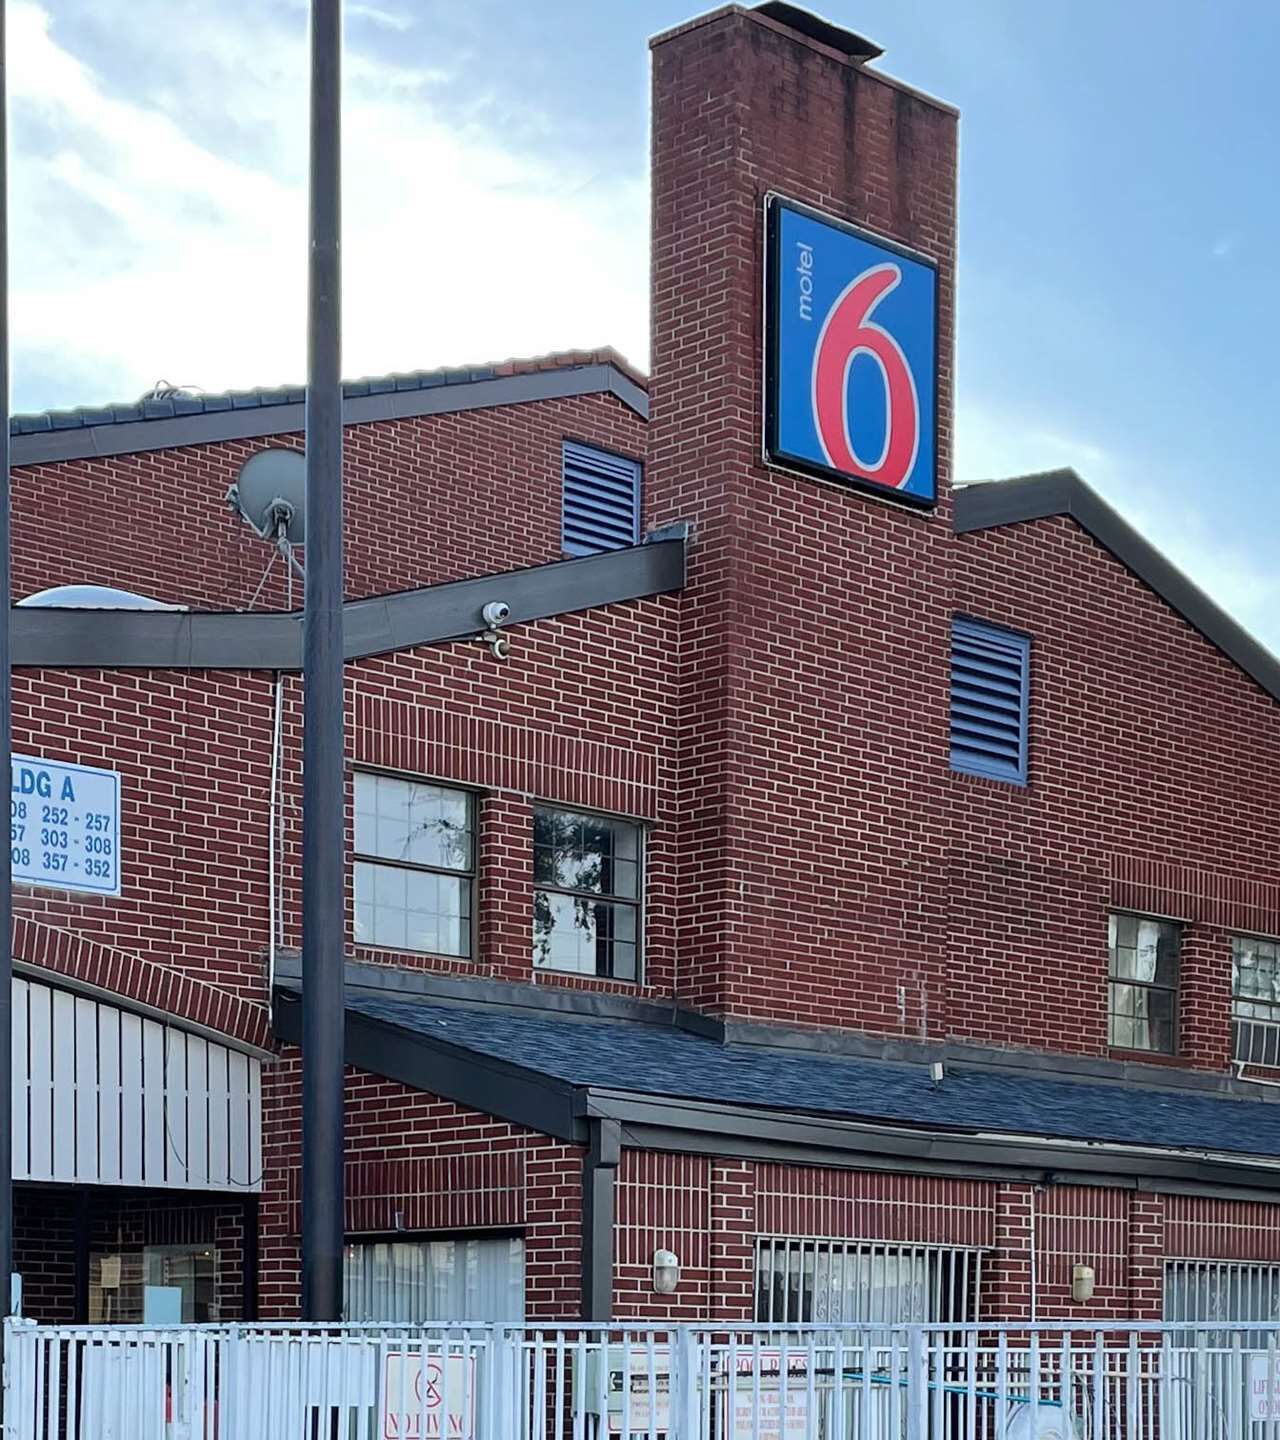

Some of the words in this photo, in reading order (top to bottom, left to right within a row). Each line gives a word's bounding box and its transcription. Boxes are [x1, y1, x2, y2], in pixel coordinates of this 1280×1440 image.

[795, 241, 815, 322] motel
[811, 261, 921, 491] 6
[11, 768, 51, 798] LDG
[61, 776, 75, 802] A
[11, 801, 27, 819] 08
[41, 805, 69, 826] 252
[85, 812, 111, 833] 257
[11, 825, 26, 842] 57
[40, 828, 68, 849] 303
[84, 835, 111, 856] 308
[11, 847, 31, 866] 08
[42, 851, 68, 872] 357
[84, 858, 111, 879] 352
